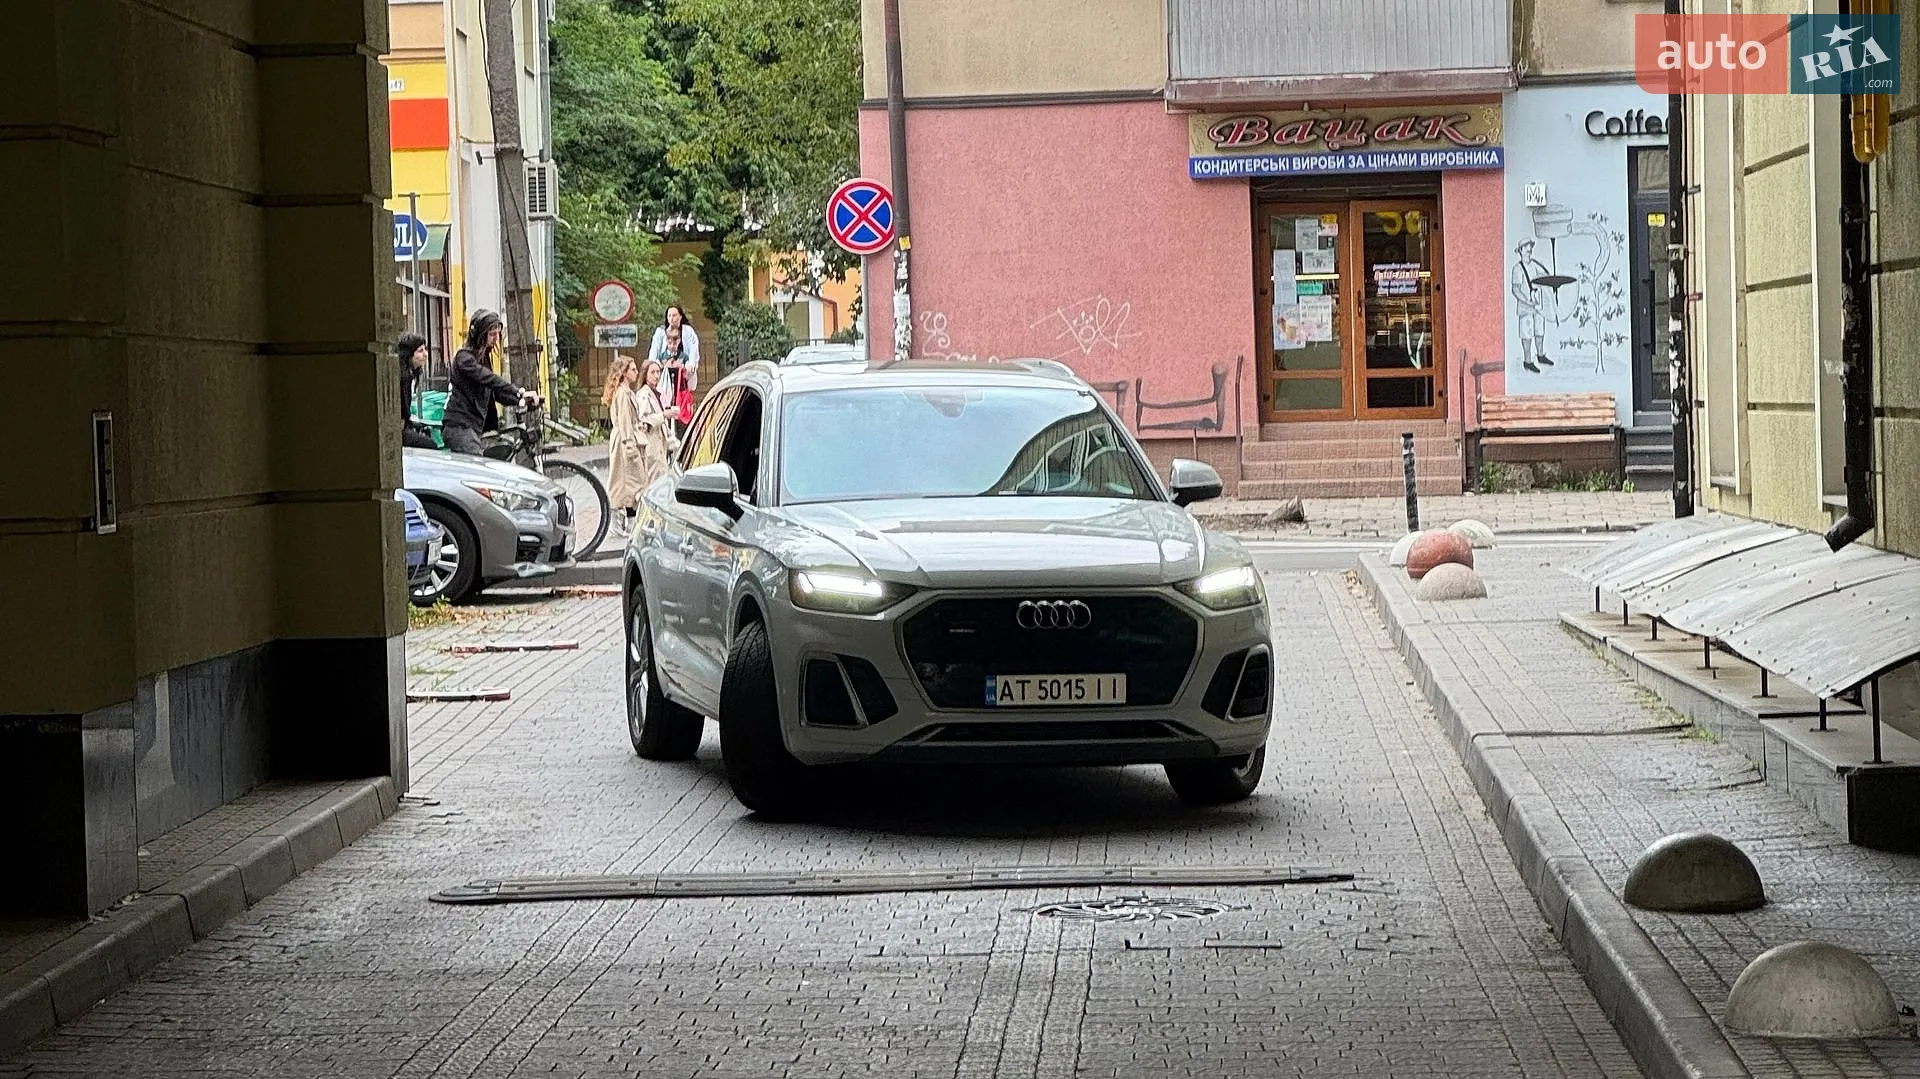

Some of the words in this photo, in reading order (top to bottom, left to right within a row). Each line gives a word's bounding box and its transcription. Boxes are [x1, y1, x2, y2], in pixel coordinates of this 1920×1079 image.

[1207, 112, 1487, 151] Вацак
[1584, 108, 1669, 137] Coffe
[1194, 157, 1290, 175] КОНДИТЕРСЬКІ
[1292, 155, 1345, 171] ВИРОБИ
[1348, 154, 1366, 169] ЗА
[1368, 152, 1417, 170] ЦІНАМИ
[1420, 149, 1499, 167] ВИРОБНИКА
[1000, 679, 1031, 701] AT
[1038, 678, 1085, 700] 5015
